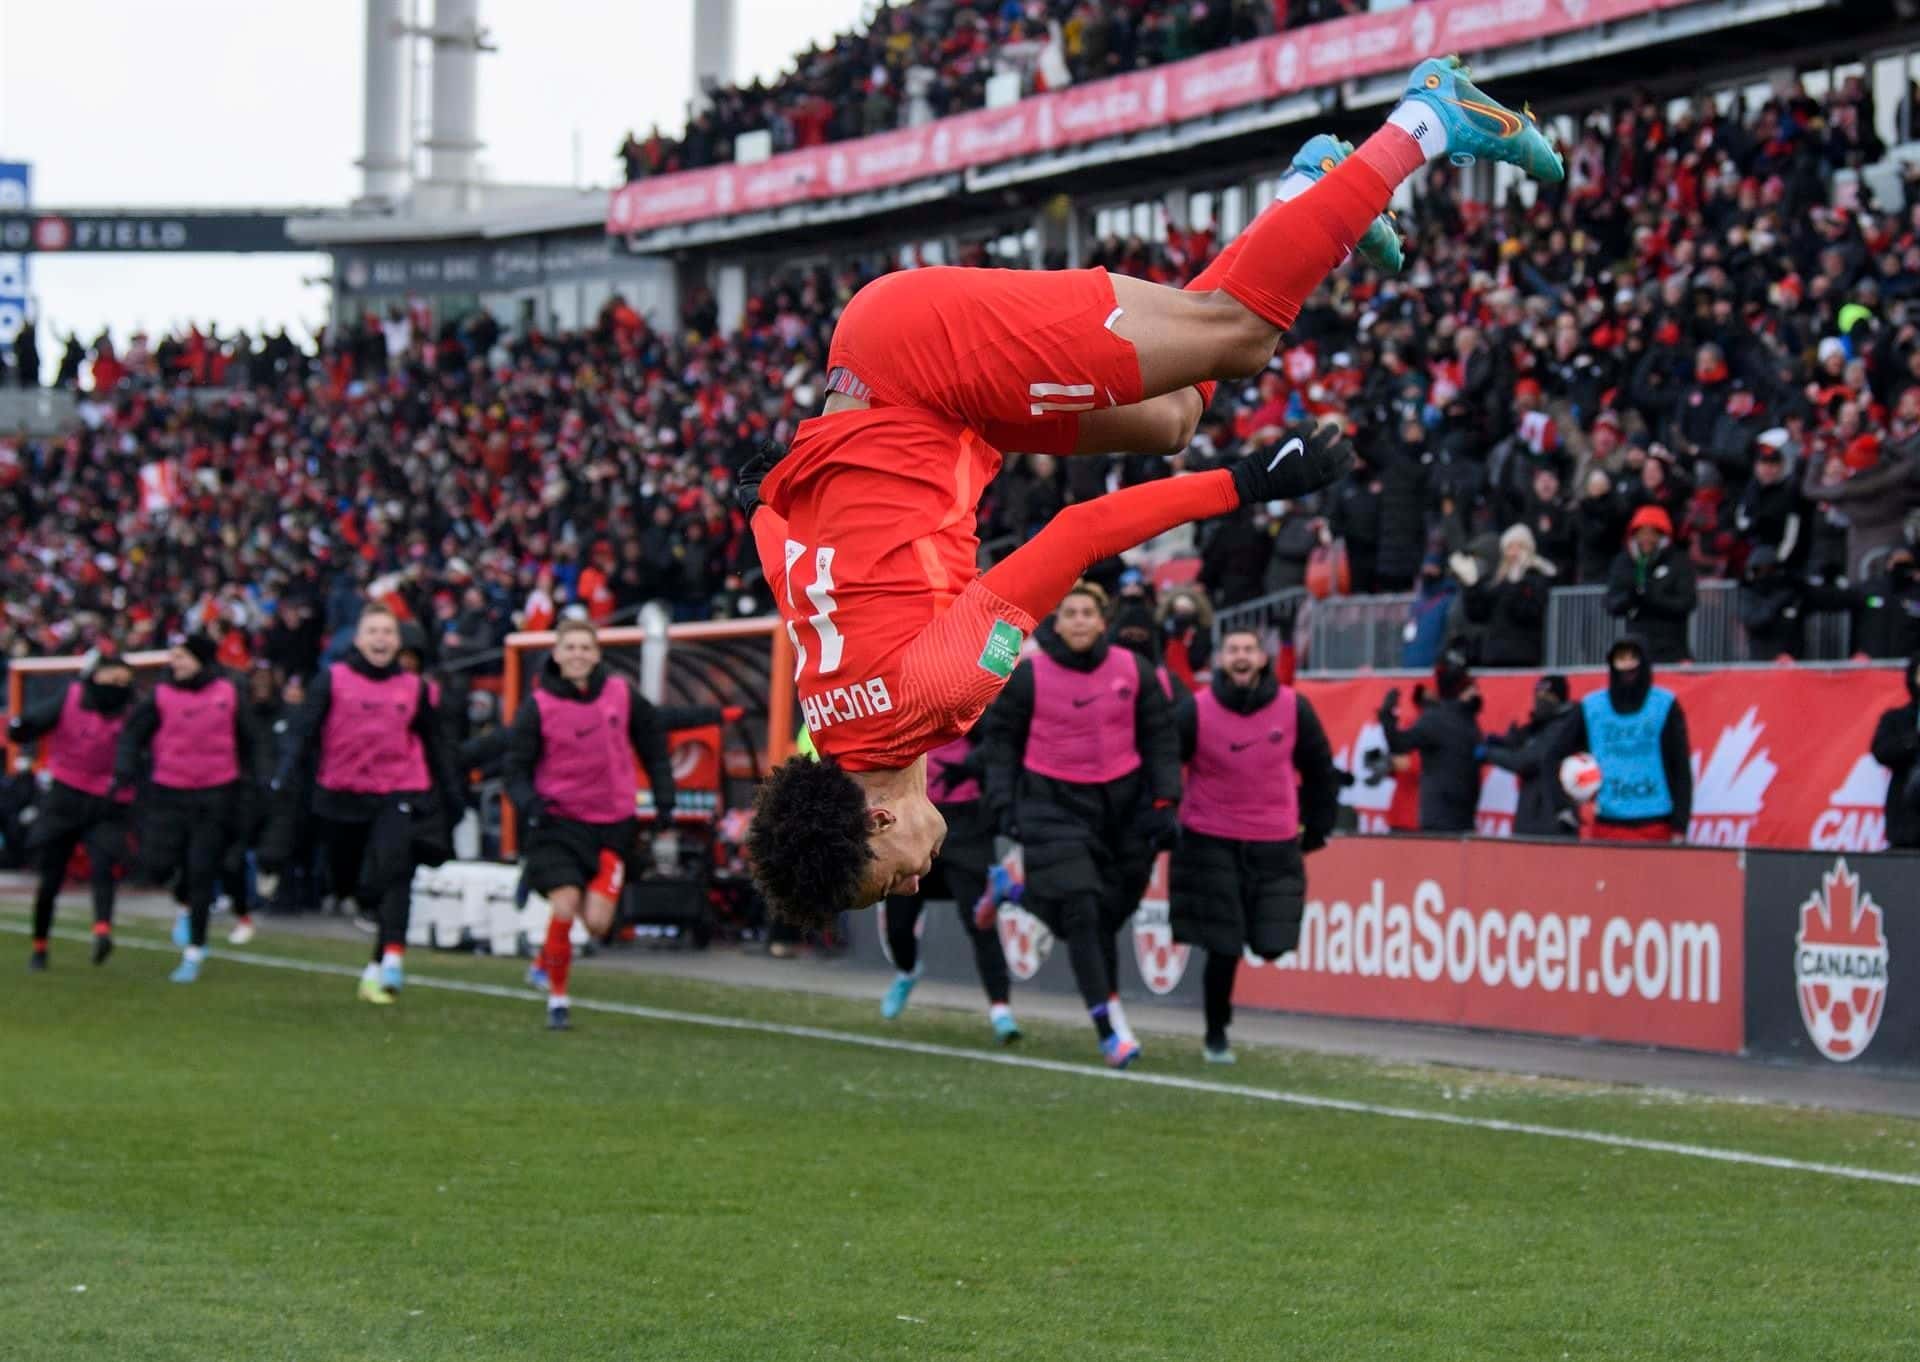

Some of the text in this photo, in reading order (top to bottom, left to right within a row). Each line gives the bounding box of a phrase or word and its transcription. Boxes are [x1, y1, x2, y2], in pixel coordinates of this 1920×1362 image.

[75, 221, 187, 248] FIELD
[1030, 383, 1095, 415] 11
[800, 676, 893, 732] BUCHA
[1243, 878, 1720, 1003] nadaSoccer.com
[1801, 951, 1885, 979] CANADA
